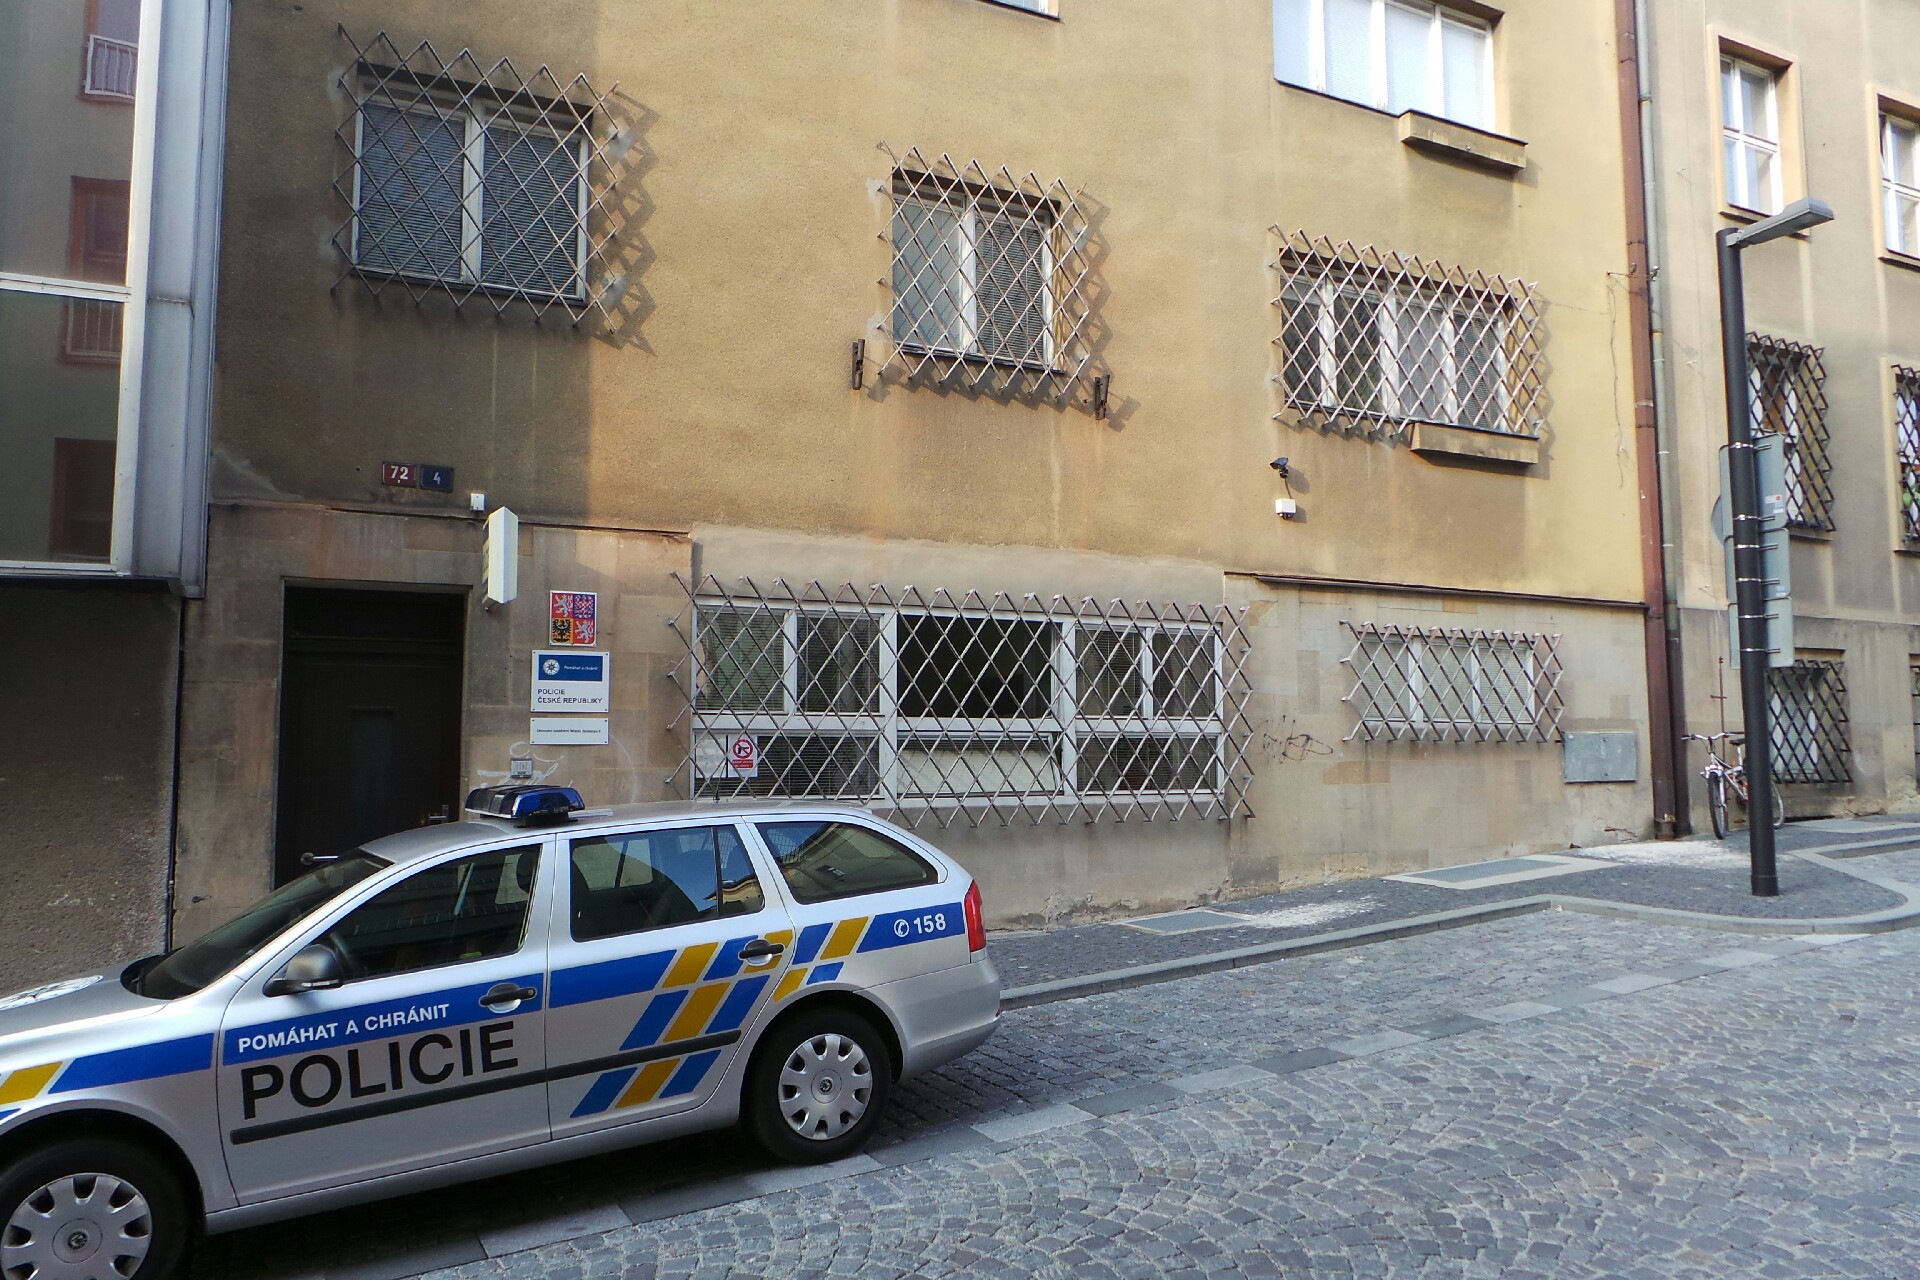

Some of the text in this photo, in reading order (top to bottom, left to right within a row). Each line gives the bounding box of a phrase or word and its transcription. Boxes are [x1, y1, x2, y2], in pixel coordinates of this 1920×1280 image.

[390, 465, 409, 480] 72
[433, 471, 441, 485] 4
[537, 696, 561, 704] ČESKÉ
[913, 912, 946, 934] 158
[238, 1003, 450, 1054] POMÁHAT A CHRÁNIT
[240, 1020, 519, 1120] POLICIE
